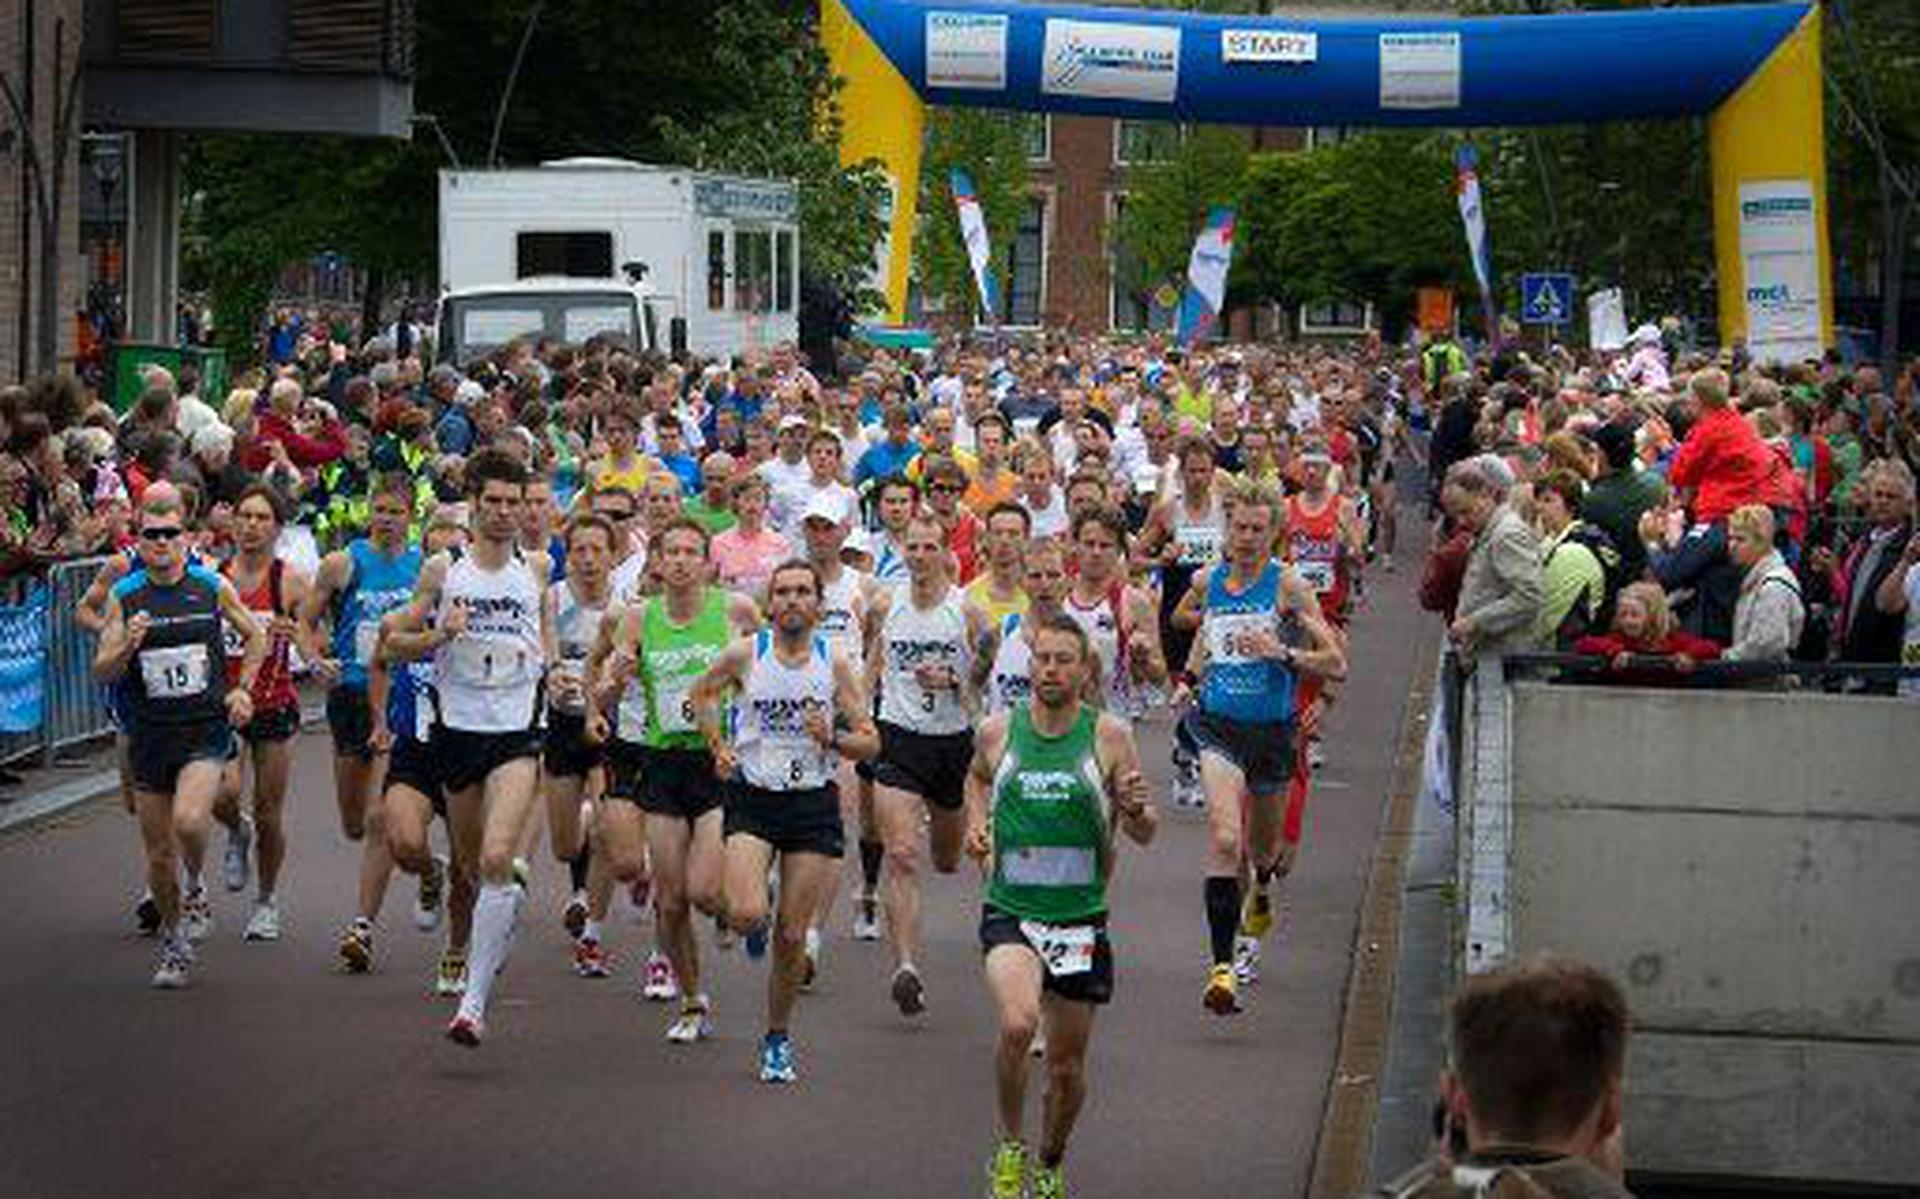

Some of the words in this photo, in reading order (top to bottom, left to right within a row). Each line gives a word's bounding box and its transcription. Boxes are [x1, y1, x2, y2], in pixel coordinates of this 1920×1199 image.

[1226, 36, 1308, 54] START
[164, 664, 188, 690] 15
[921, 691, 935, 713] 3
